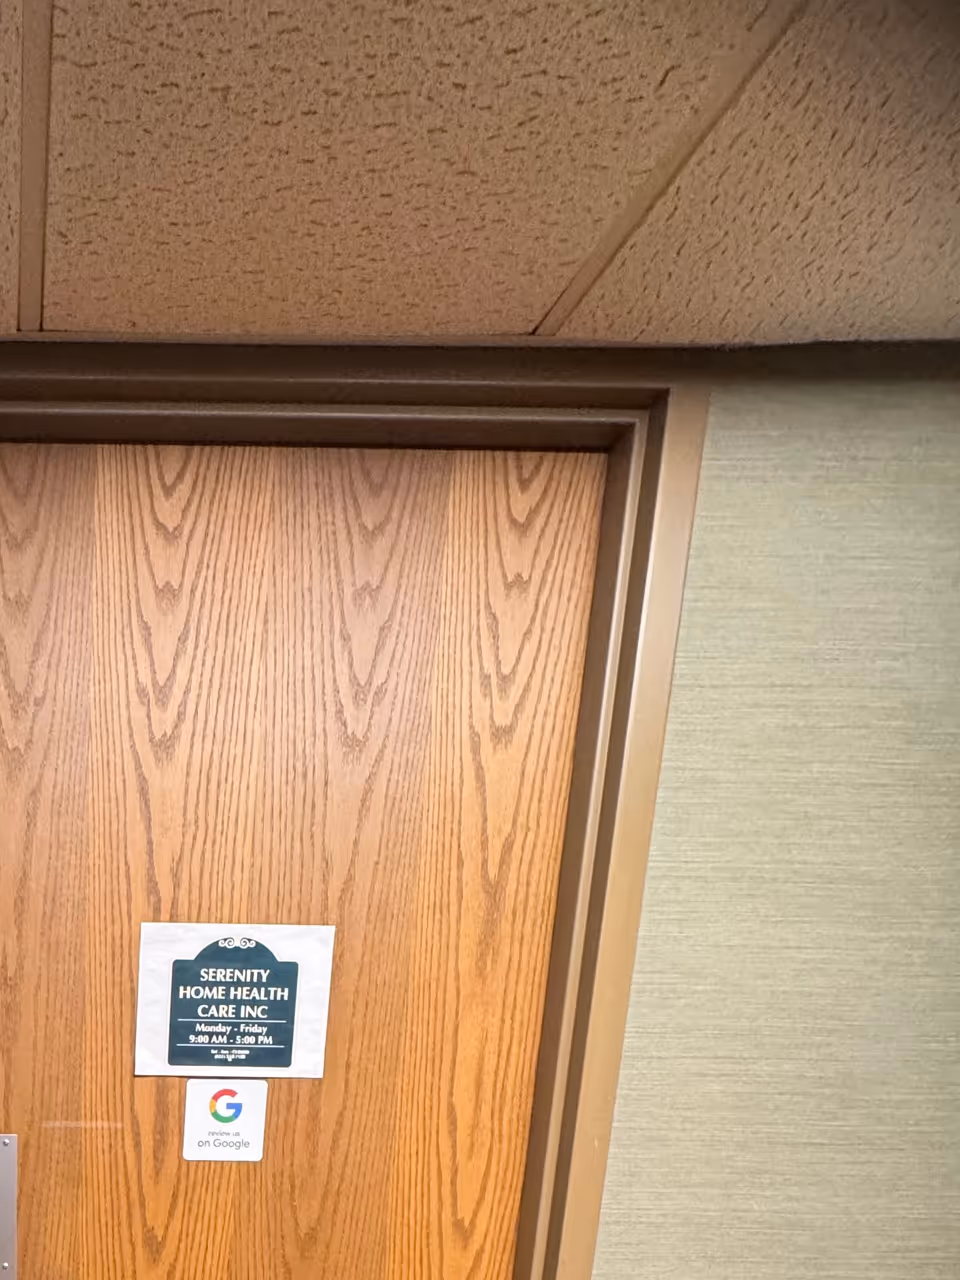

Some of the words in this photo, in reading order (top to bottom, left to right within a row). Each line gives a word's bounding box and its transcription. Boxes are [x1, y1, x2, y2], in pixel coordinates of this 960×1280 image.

[200, 968, 270, 983] SERENITY
[179, 985, 225, 1000] HOME
[229, 986, 289, 1001] HEALTH
[197, 1004, 236, 1018] CARE
[240, 1004, 269, 1019] INC
[195, 1023, 232, 1034] Monday
[240, 1024, 268, 1035] Friday
[189, 1034, 209, 1044] 9:00
[211, 1034, 227, 1044] AM
[236, 1035, 256, 1045] 5:00
[258, 1036, 273, 1045] PM
[197, 1140, 211, 1148] on
[213, 1138, 250, 1151] Google
